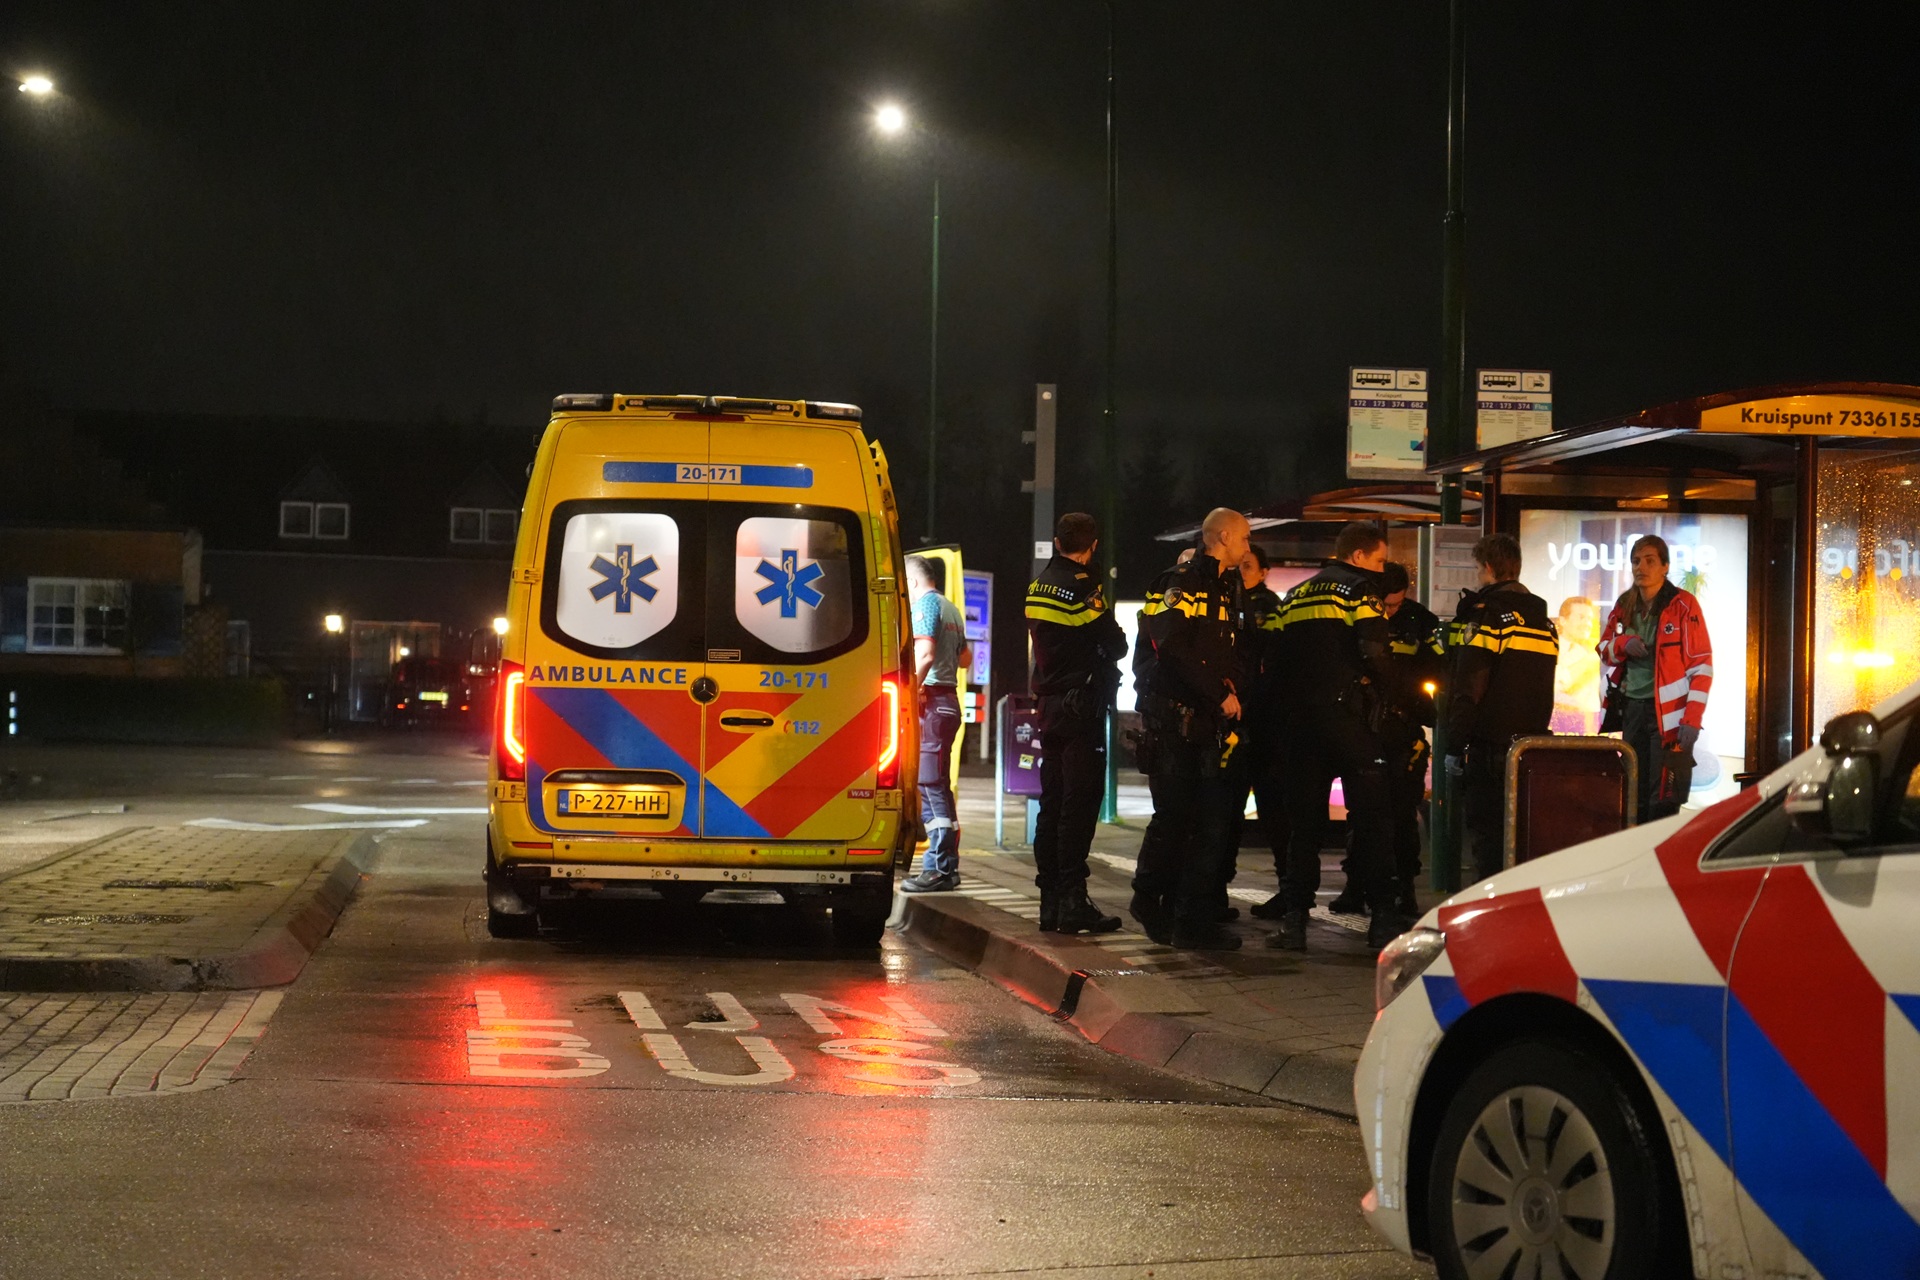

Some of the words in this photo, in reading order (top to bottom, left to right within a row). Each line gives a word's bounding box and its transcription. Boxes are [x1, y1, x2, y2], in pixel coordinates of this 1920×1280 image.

[1353, 399, 1367, 407] 172
[1741, 408, 1833, 429] Kruispunt
[1839, 410, 1920, 428] 7336155
[682, 467, 736, 481] 20-171
[1548, 533, 1718, 581] youfne
[529, 665, 687, 684] AMBULANCE
[759, 671, 829, 689] 20-171
[574, 793, 661, 811] P-227-HH
[850, 790, 870, 798] WAS
[474, 990, 950, 1037] LIJN
[466, 1029, 982, 1088] BUS
